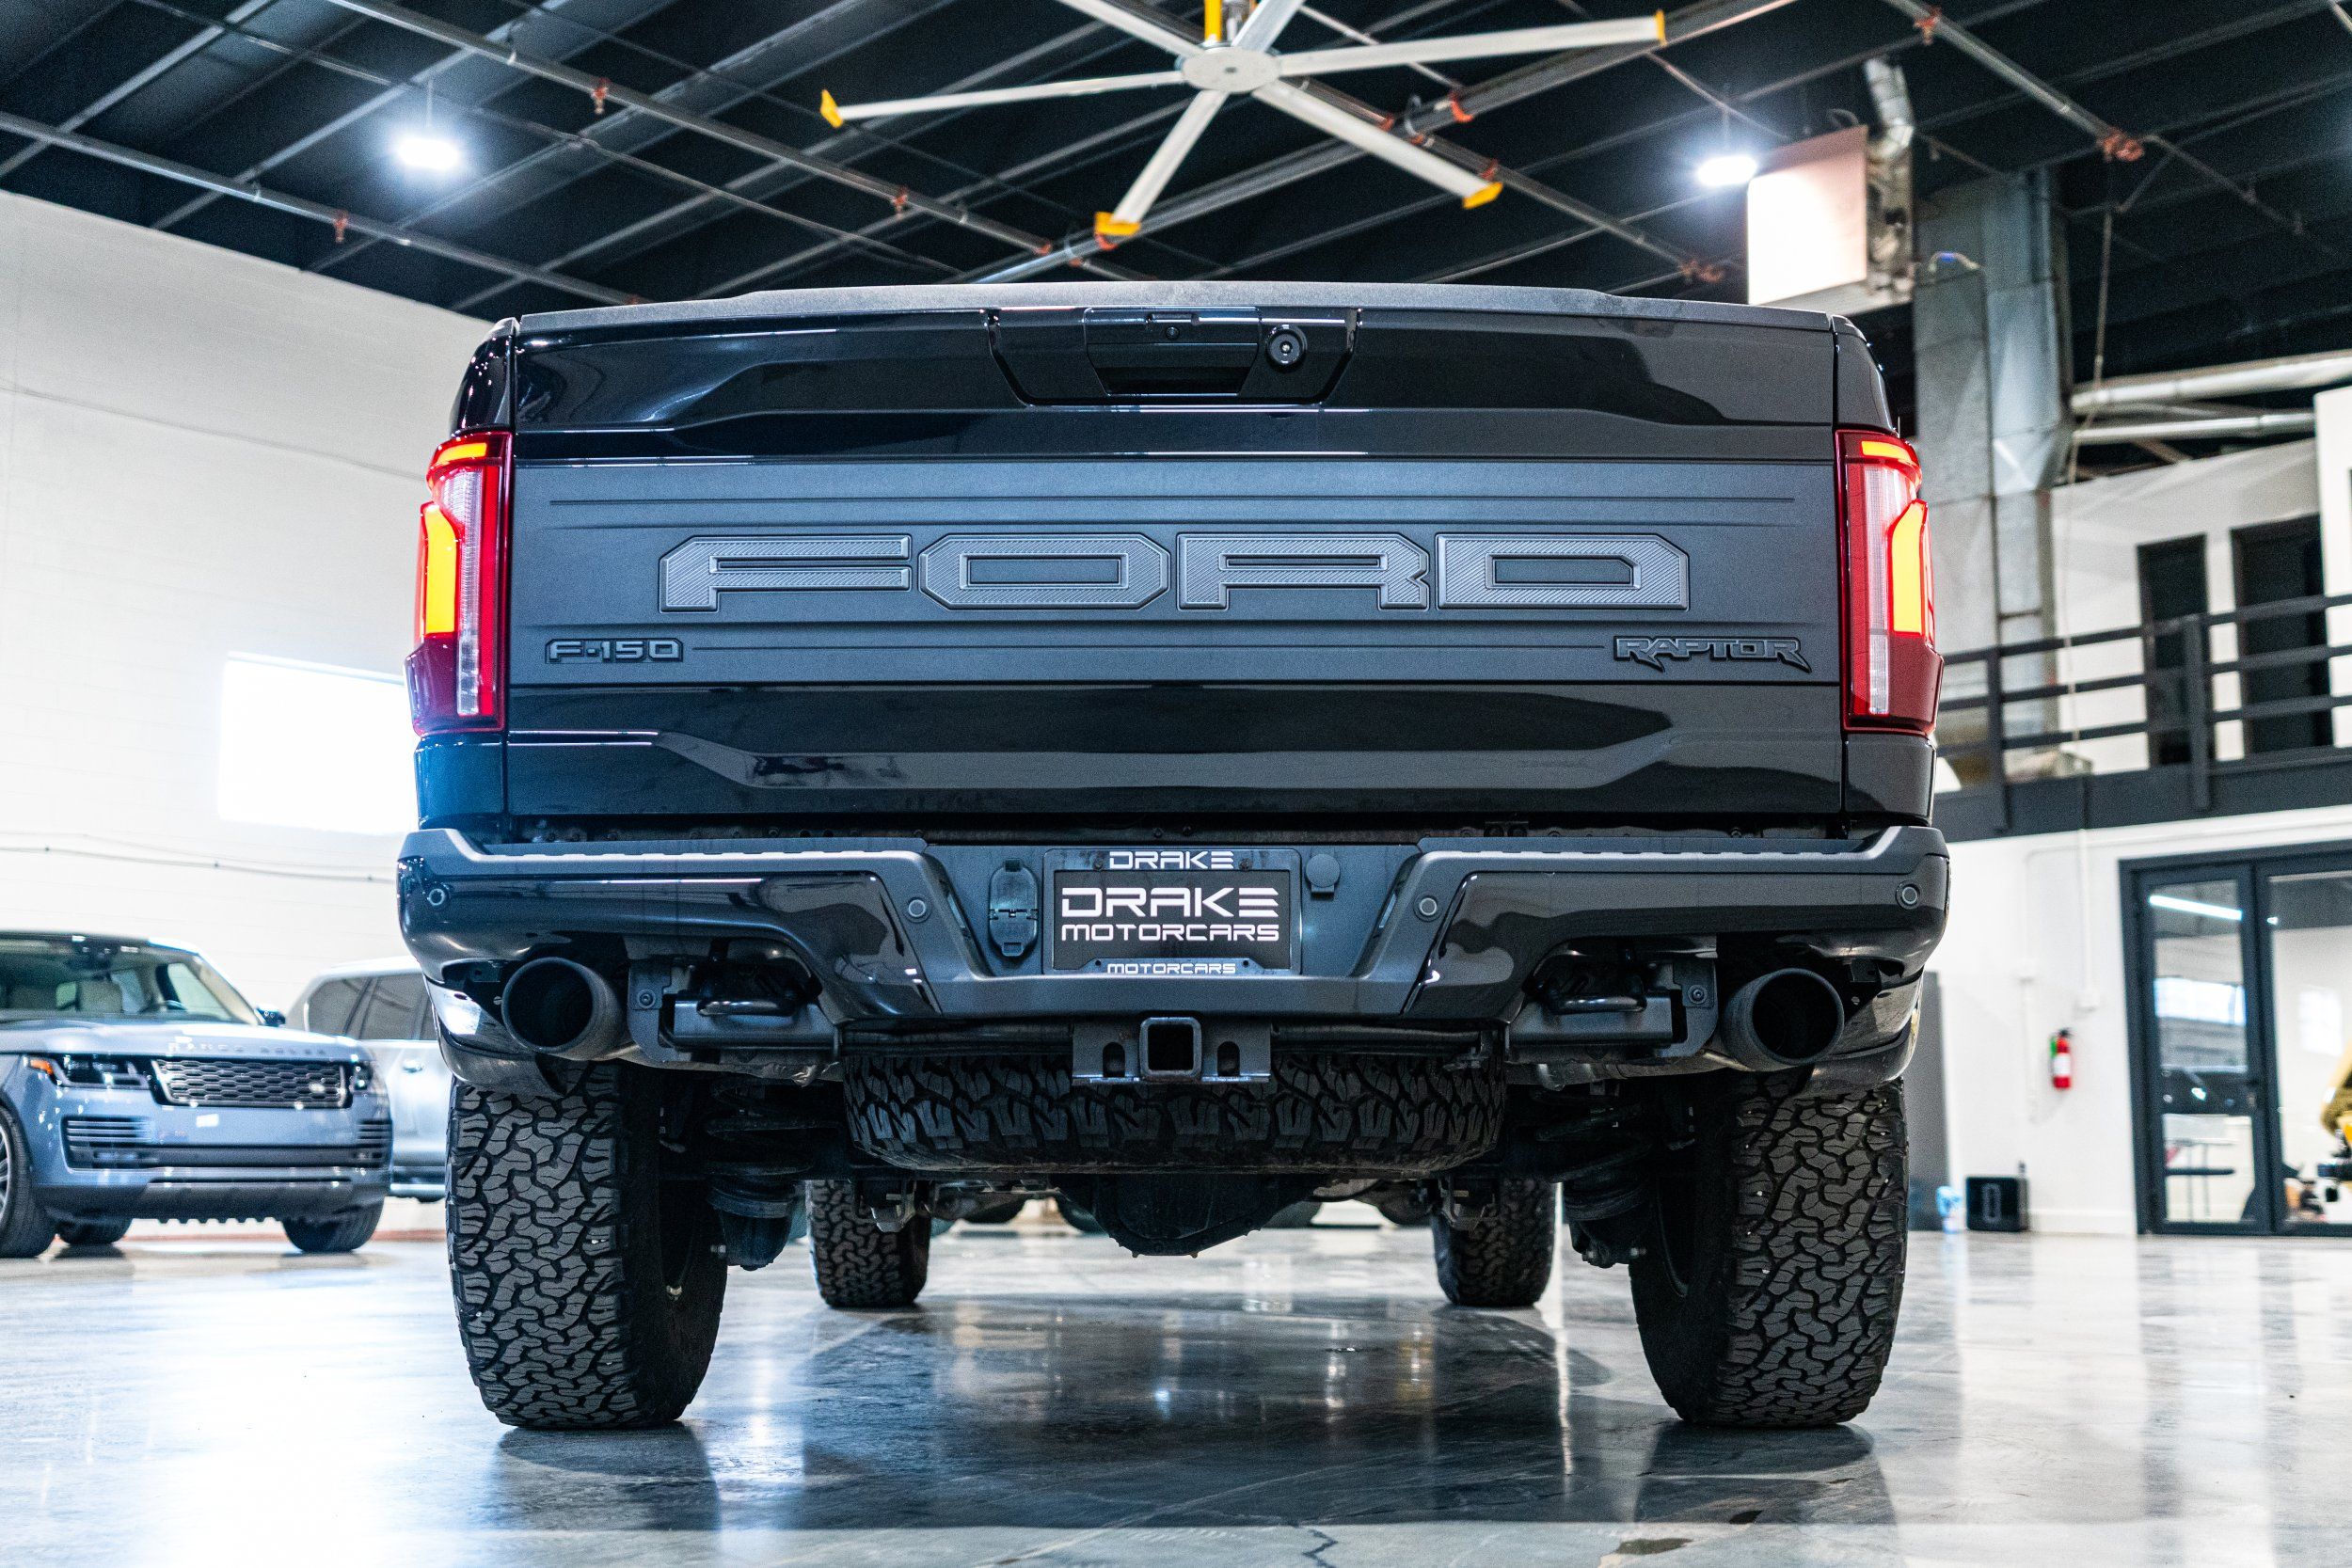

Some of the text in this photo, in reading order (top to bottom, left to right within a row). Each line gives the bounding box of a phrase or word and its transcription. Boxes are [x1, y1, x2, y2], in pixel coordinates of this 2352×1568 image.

[659, 532, 1691, 612] FORD
[546, 637, 683, 662] F-150
[1612, 635, 1812, 673] RAPTOR
[1109, 851, 1234, 869] DRAKE
[1061, 887, 1279, 917] DRAKE
[1061, 924, 1279, 942] MOTORCARS
[1107, 963, 1236, 974] MOTORCARS
